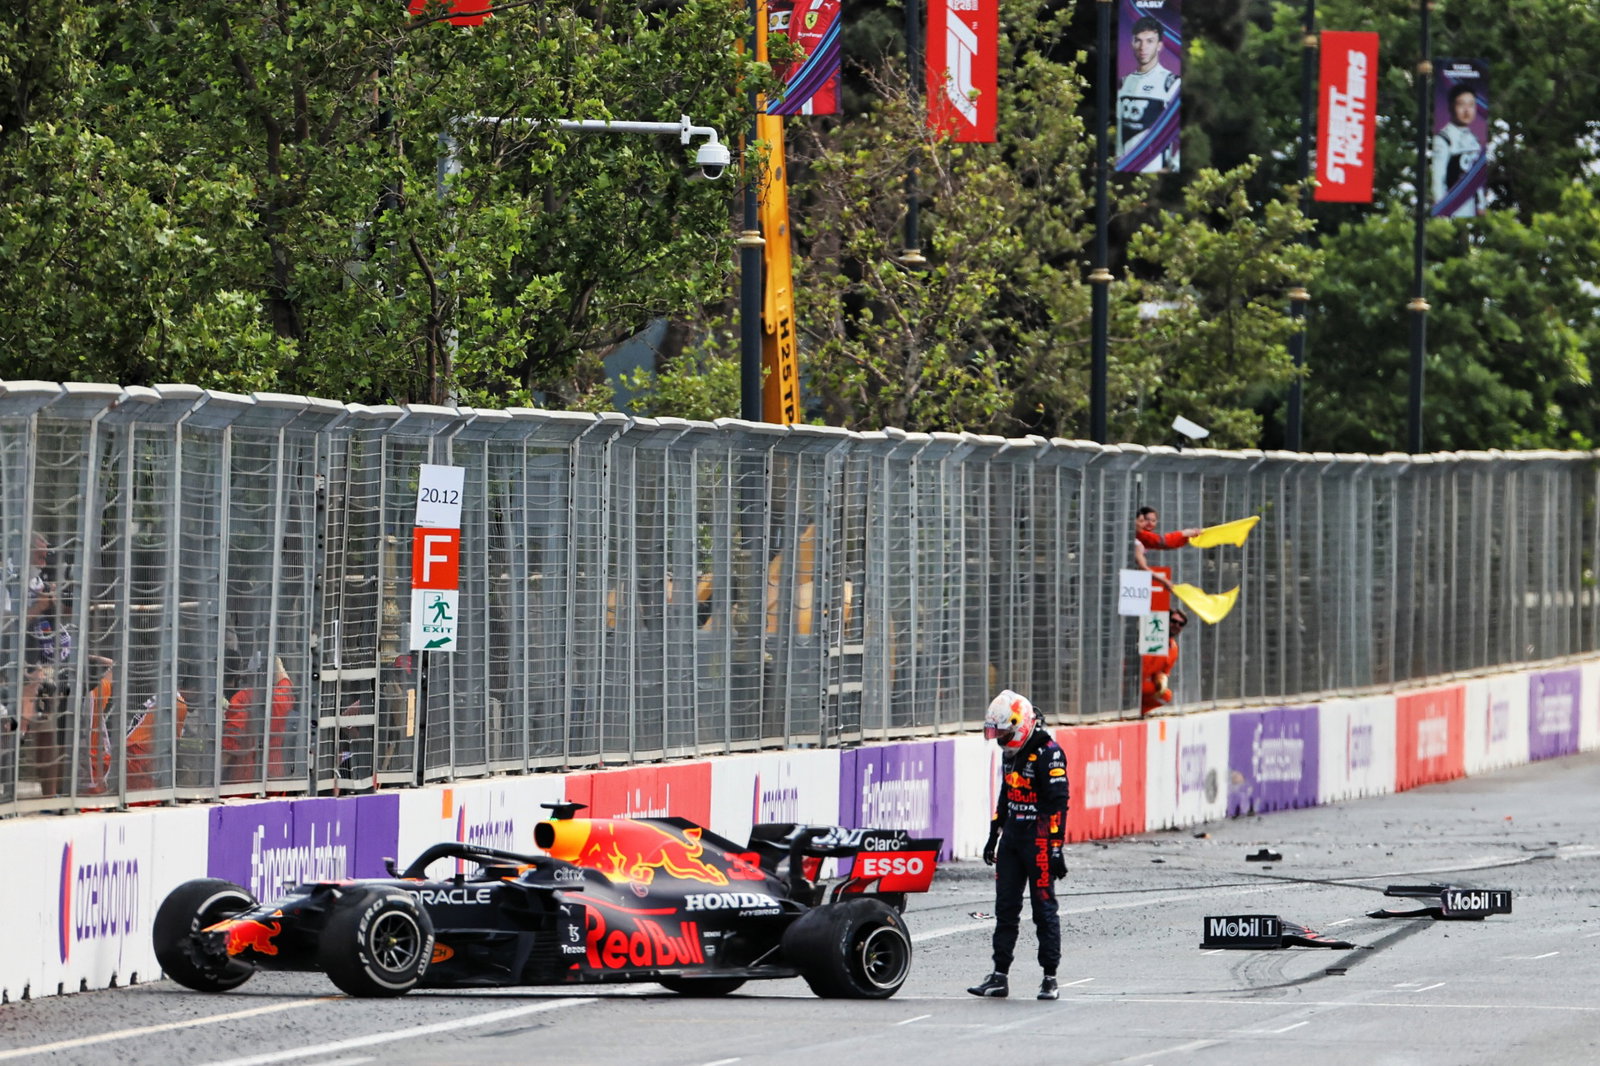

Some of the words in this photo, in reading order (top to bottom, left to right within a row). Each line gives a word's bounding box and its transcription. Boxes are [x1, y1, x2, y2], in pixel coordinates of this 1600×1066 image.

[1327, 85, 1346, 184] STREET
[421, 487, 458, 505] 20.12
[422, 535, 452, 582] F
[1122, 586, 1149, 599] 20.10
[864, 834, 901, 851] Claro
[554, 867, 586, 881] citrix
[863, 858, 923, 875] ESSO
[76, 822, 139, 970] azerbaijan
[684, 893, 779, 911] HONDA
[1447, 892, 1489, 911] Mobil
[739, 908, 780, 917] HYBRID
[1210, 918, 1259, 937] Mobil
[562, 945, 586, 954] Tezos
